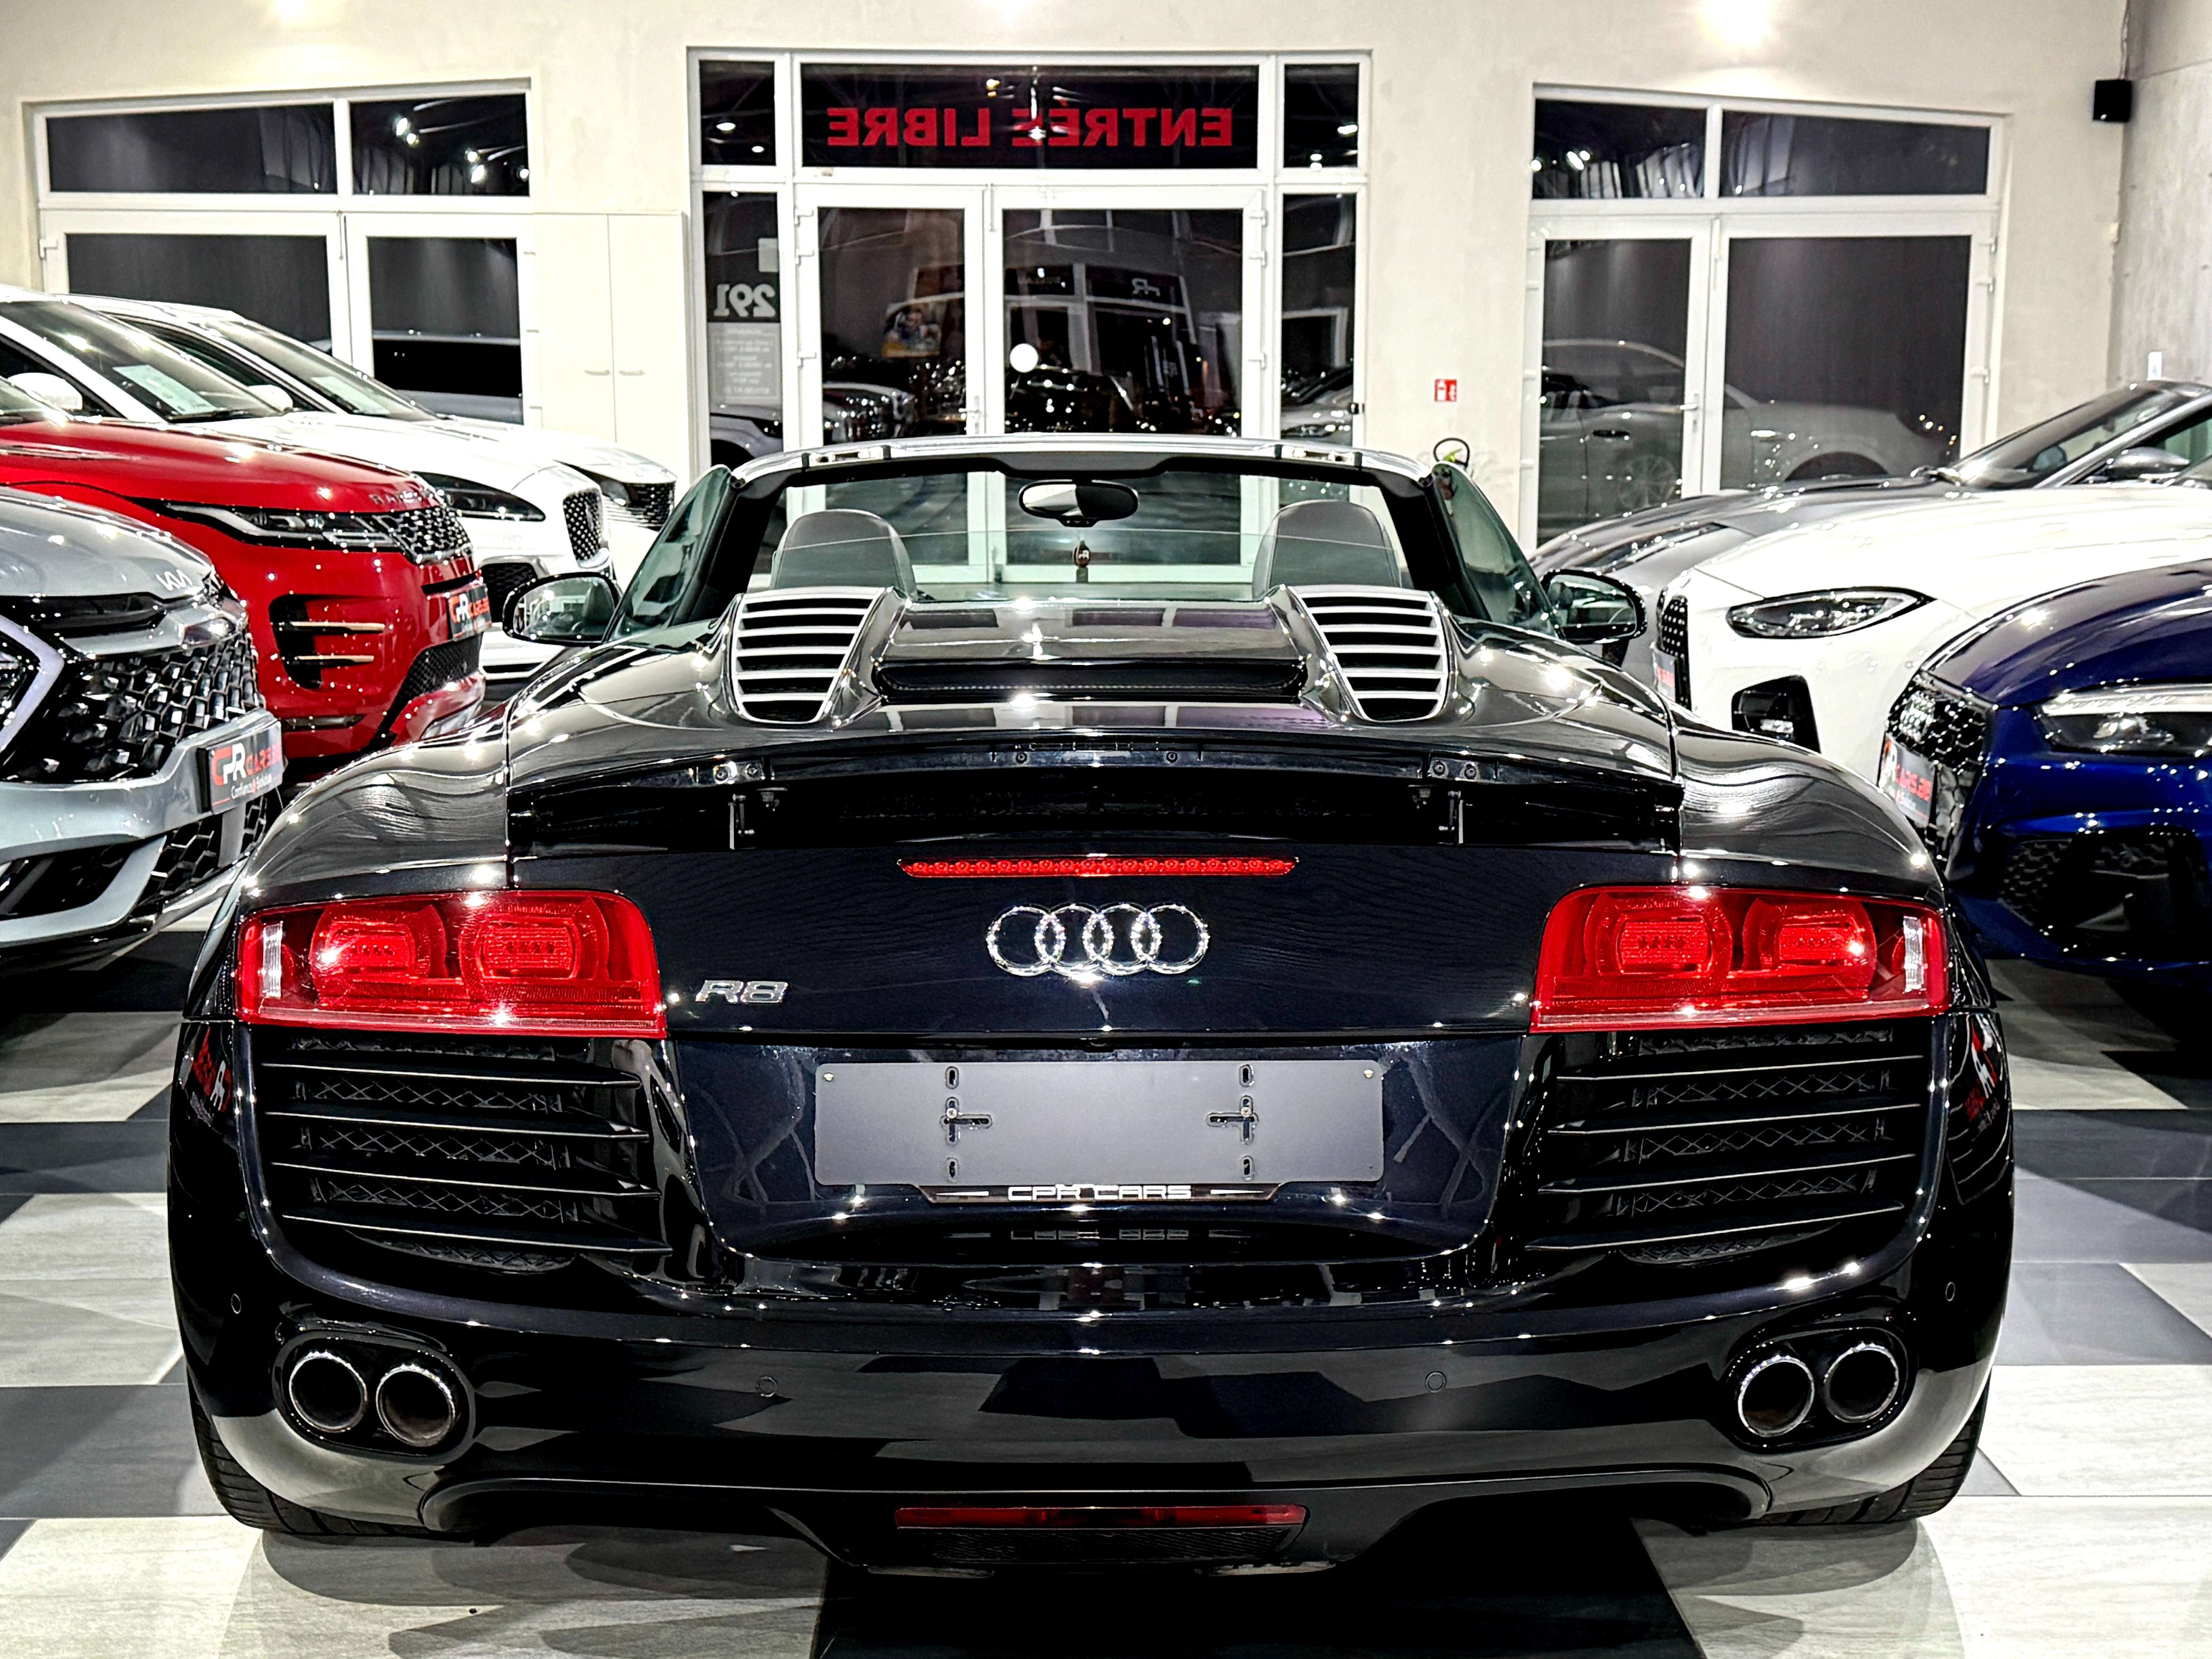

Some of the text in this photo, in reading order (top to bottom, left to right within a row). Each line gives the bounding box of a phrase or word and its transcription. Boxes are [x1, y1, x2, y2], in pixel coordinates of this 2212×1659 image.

[211, 743, 247, 787] CPR
[695, 979, 789, 1003] R8
[1008, 1184, 1192, 1201] CPR CARS
